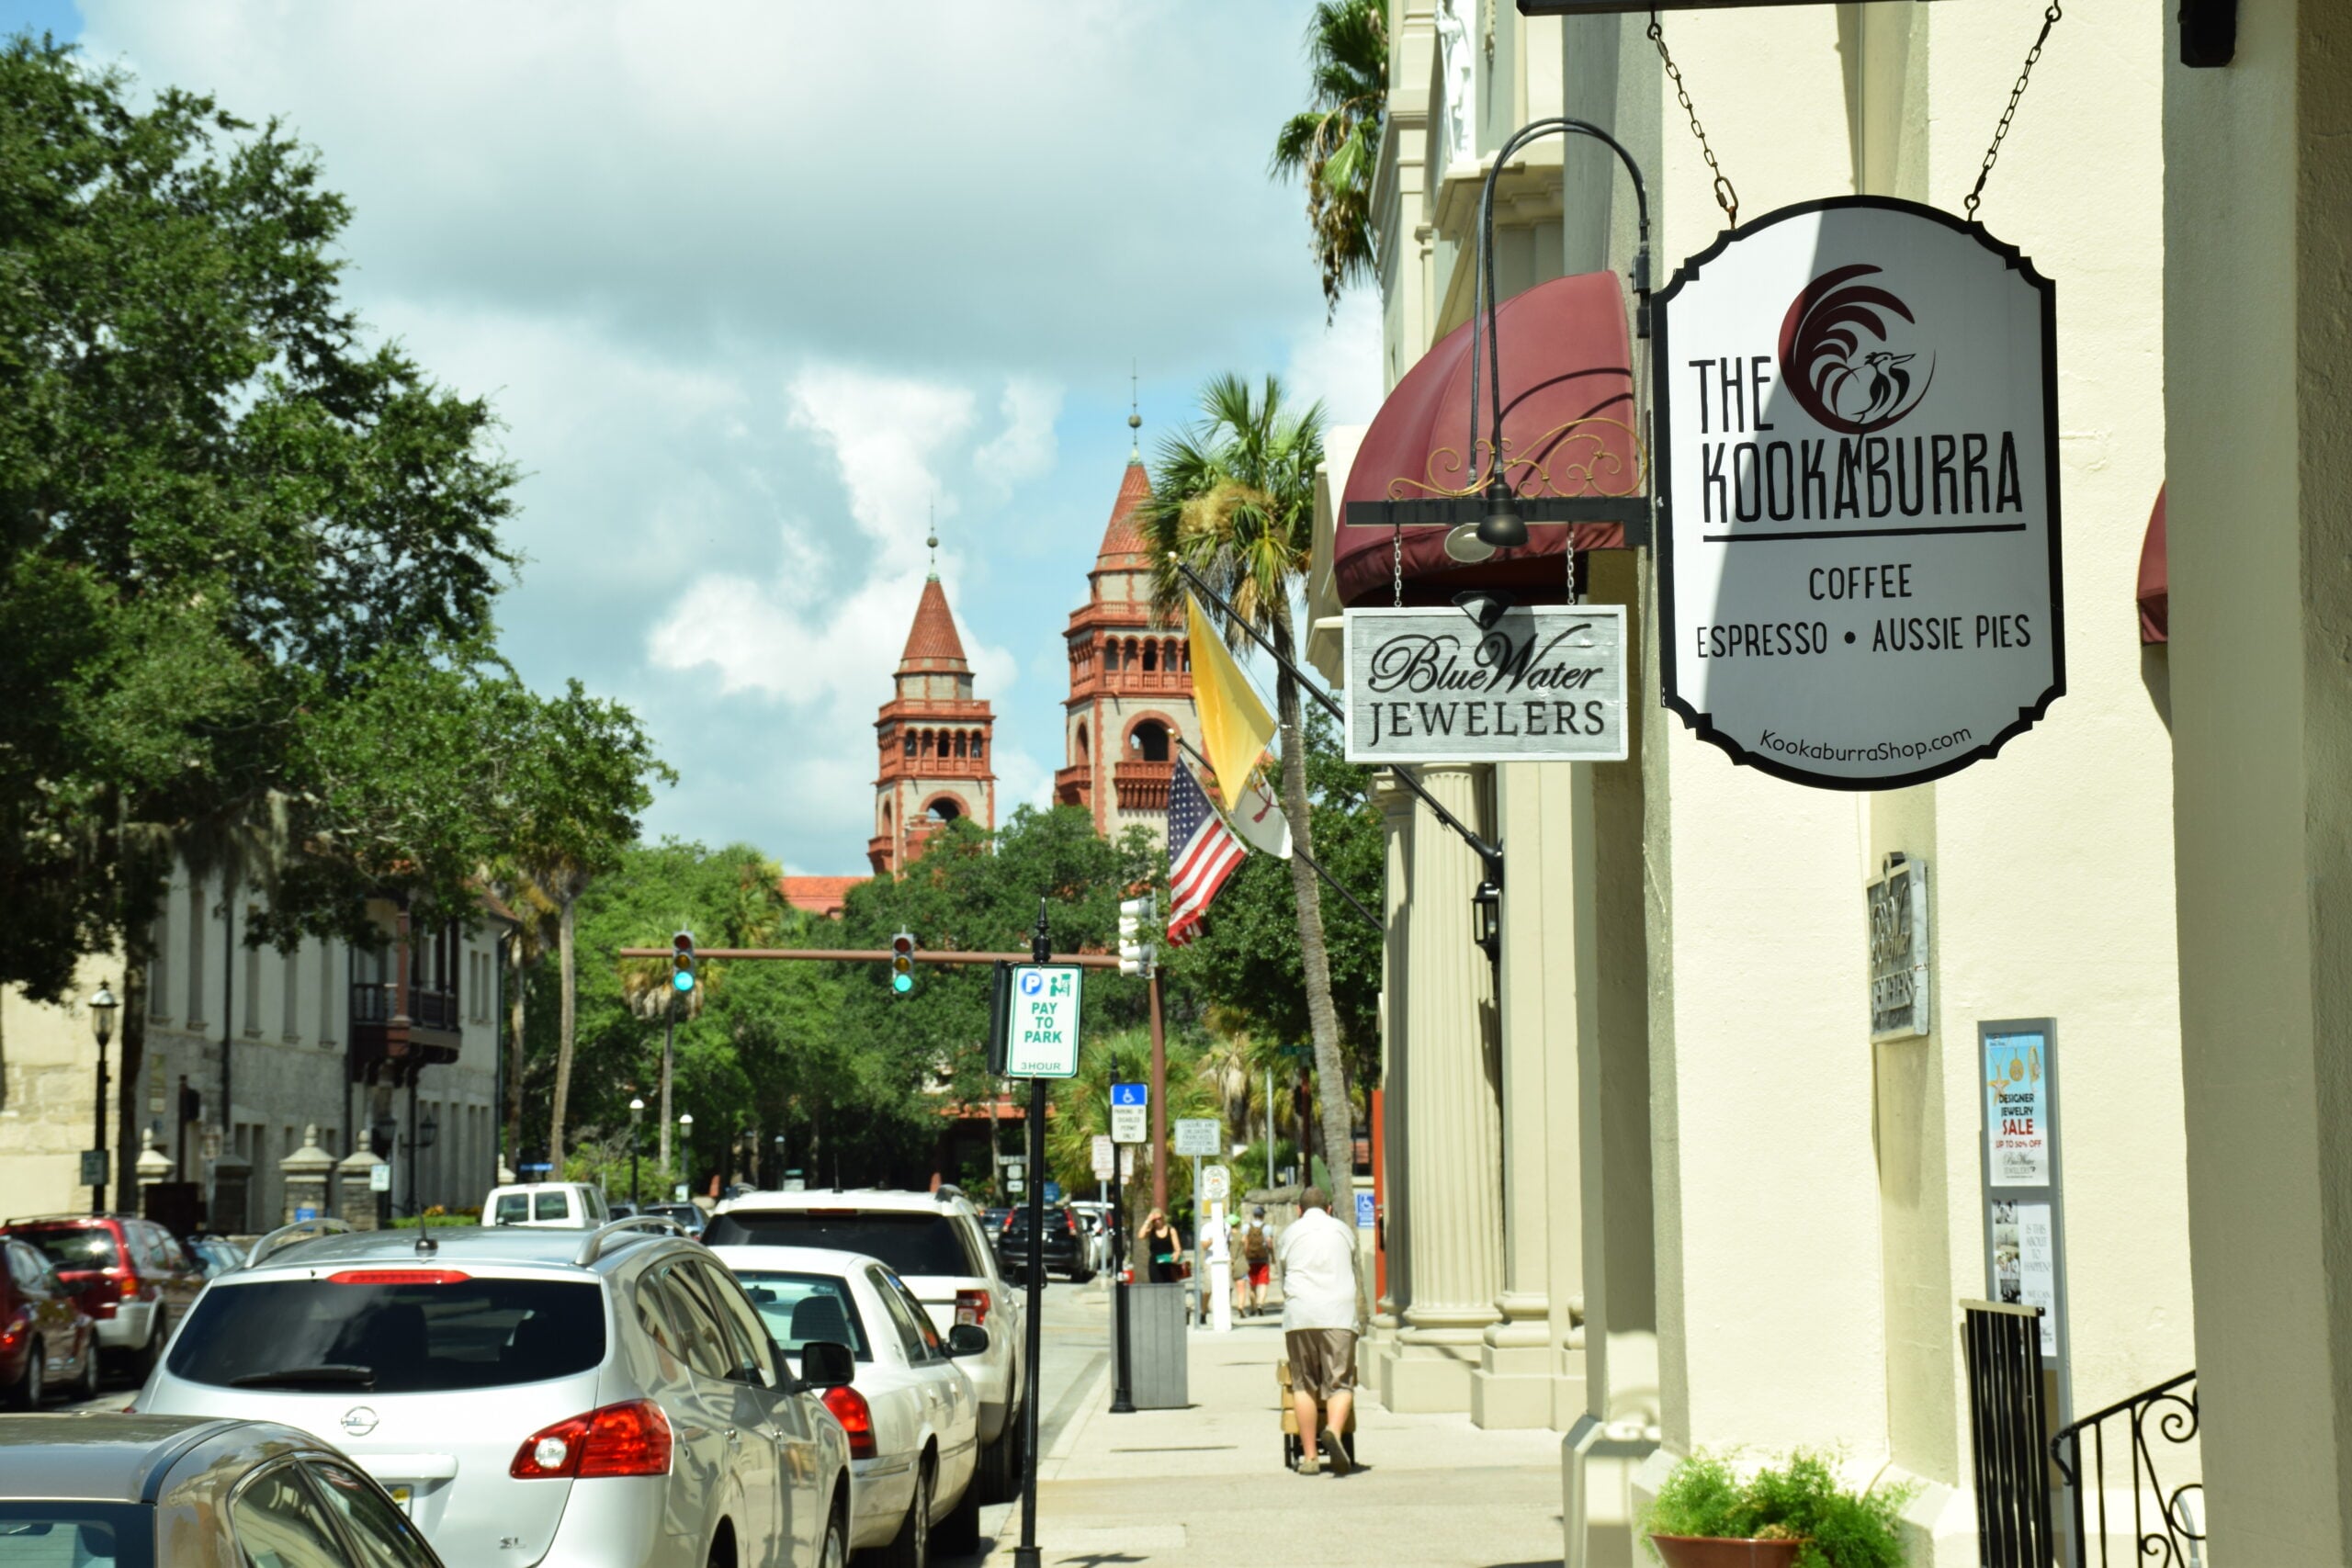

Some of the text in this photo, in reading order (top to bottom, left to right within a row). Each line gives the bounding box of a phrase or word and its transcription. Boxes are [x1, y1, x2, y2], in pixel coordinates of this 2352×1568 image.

[1689, 355, 1774, 434] THE
[1702, 431, 2023, 524] KOOKABURRA
[1809, 563, 1913, 601] COFFEE
[1696, 614, 2031, 659] ESPRESSO AUSSIE PIES
[1369, 700, 1604, 747] JEWELERS
[1760, 728, 1973, 763] KookaburraShop.com
[1031, 1002, 1057, 1014] PAY
[1035, 1016, 1054, 1029] TO
[1024, 1031, 1062, 1043] PARK
[1998, 1093, 2035, 1104] DESIGNER
[2000, 1106, 2034, 1117] JEWELRY
[2003, 1118, 2033, 1135] SALE
[1996, 1140, 2004, 1148] UP
[2006, 1140, 2014, 1148] TO
[2029, 1139, 2042, 1147] OFF
[500, 1537, 526, 1550] SL
